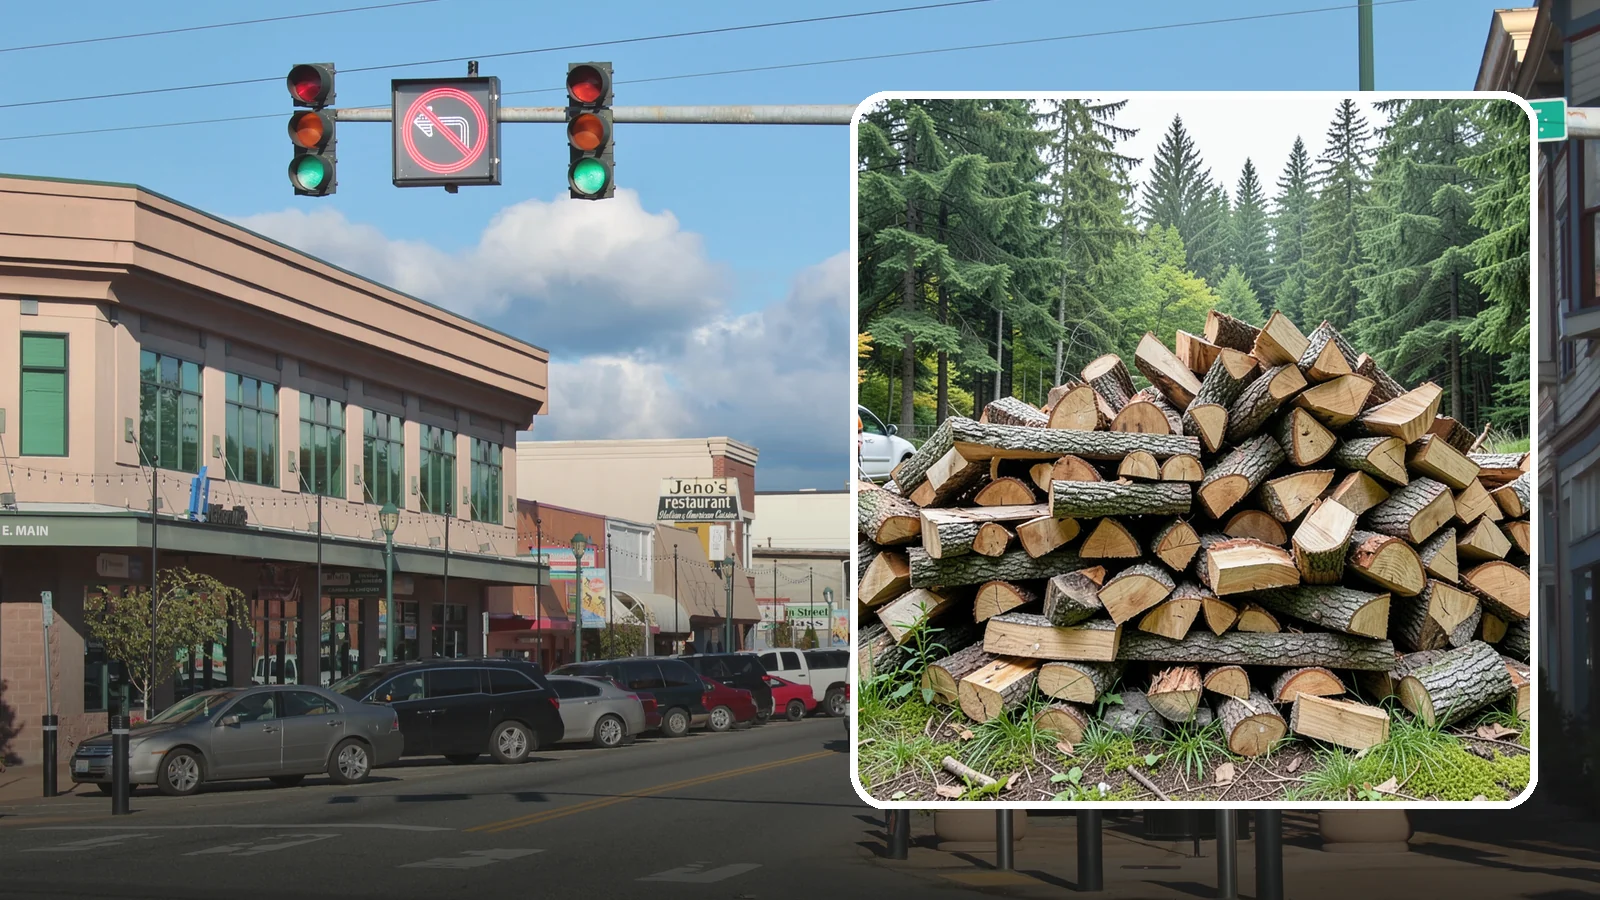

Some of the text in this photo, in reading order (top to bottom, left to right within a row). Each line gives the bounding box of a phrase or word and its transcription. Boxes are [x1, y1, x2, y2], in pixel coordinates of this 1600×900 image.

[669, 480, 727, 494] Jeno's
[665, 496, 731, 509] restaurant
[658, 510, 682, 519] Italian
[686, 510, 714, 519] American
[715, 509, 737, 519] Cuisine
[2, 525, 49, 536] E. MAIN
[797, 607, 828, 616] Street
[791, 619, 824, 627] lass
